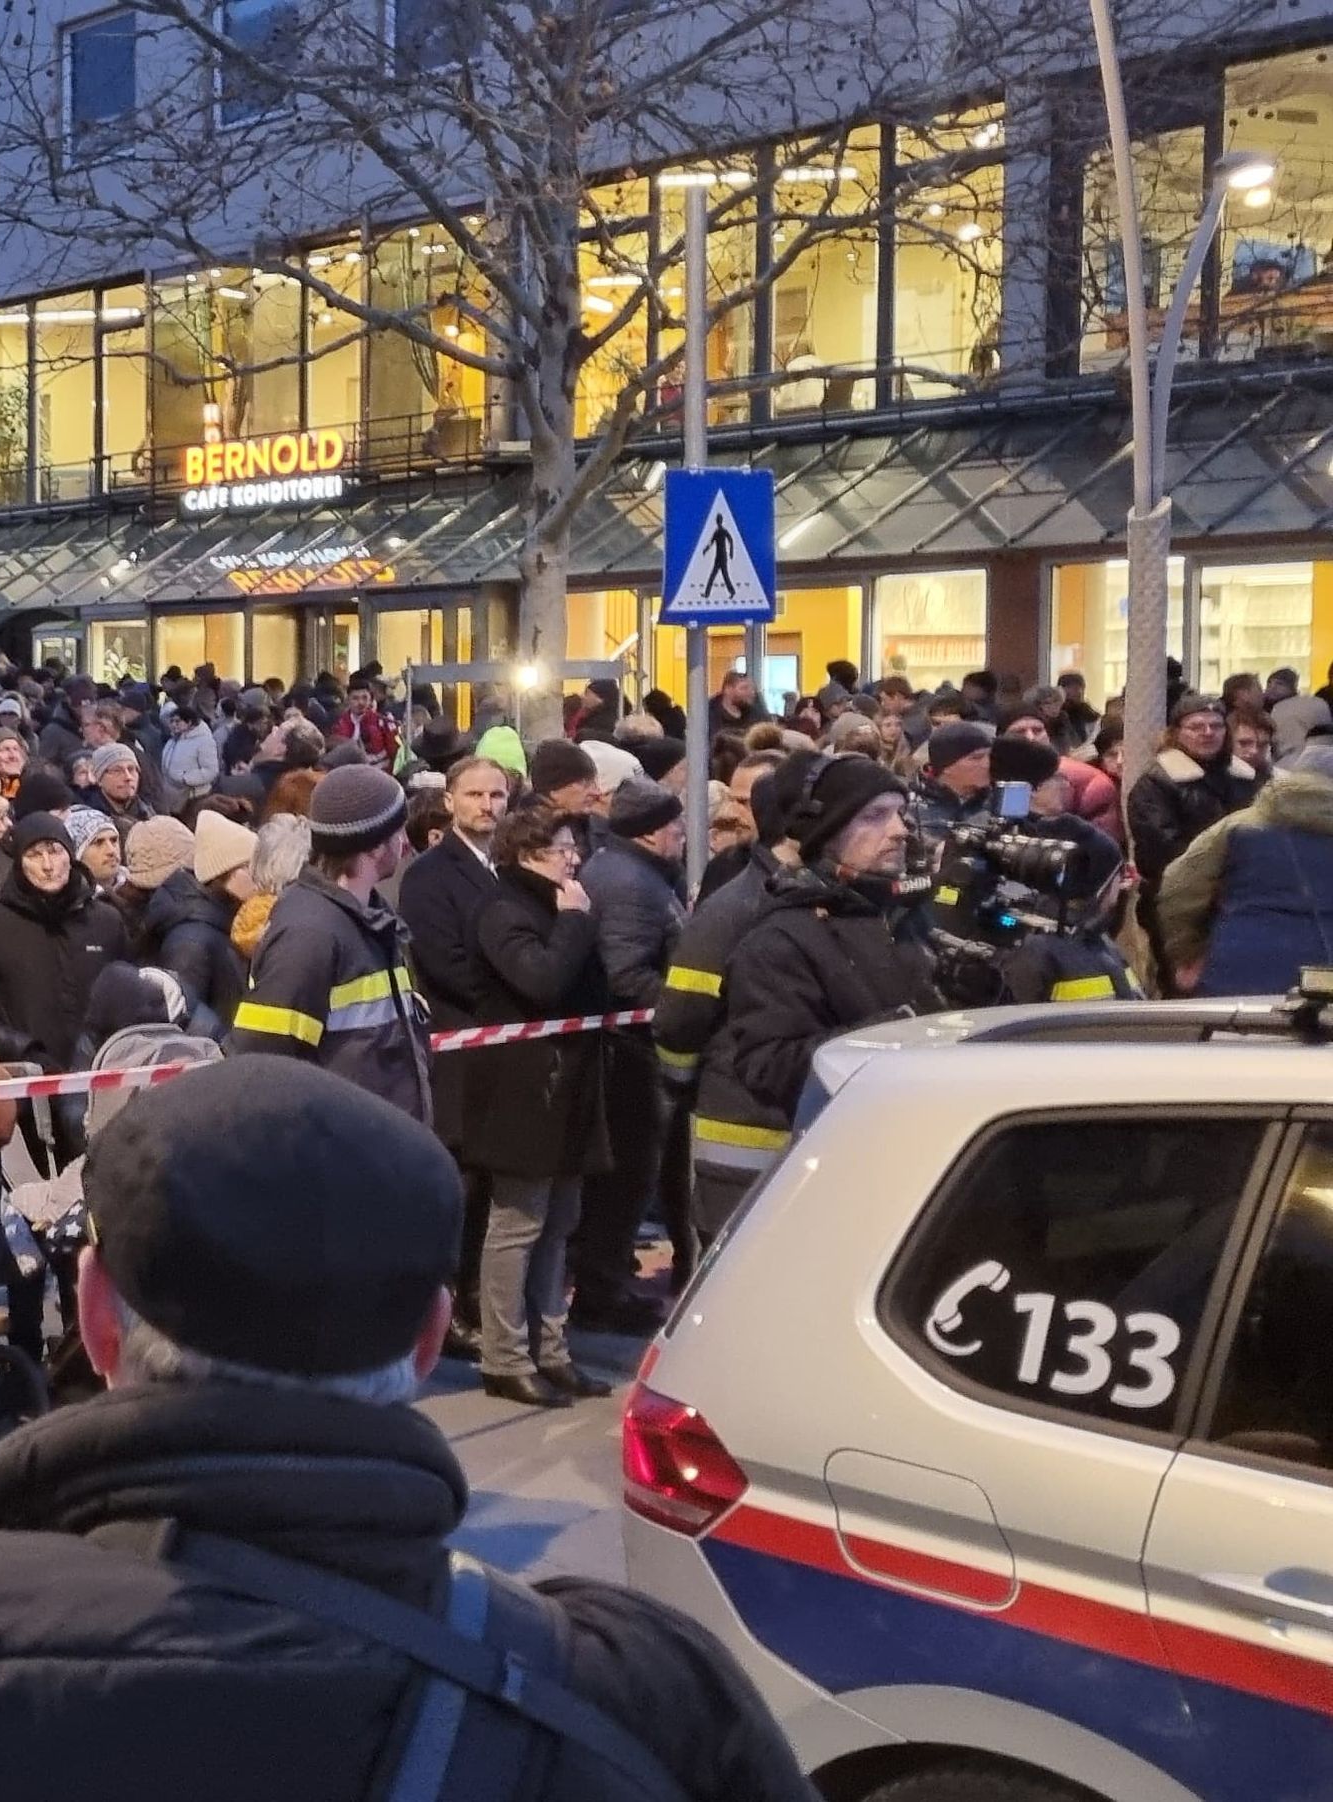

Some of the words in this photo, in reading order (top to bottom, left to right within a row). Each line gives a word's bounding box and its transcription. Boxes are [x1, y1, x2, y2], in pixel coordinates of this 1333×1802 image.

[183, 429, 344, 485] BERNOLD
[231, 475, 343, 506] KONDITOREI
[1013, 1292, 1181, 1409] 133
